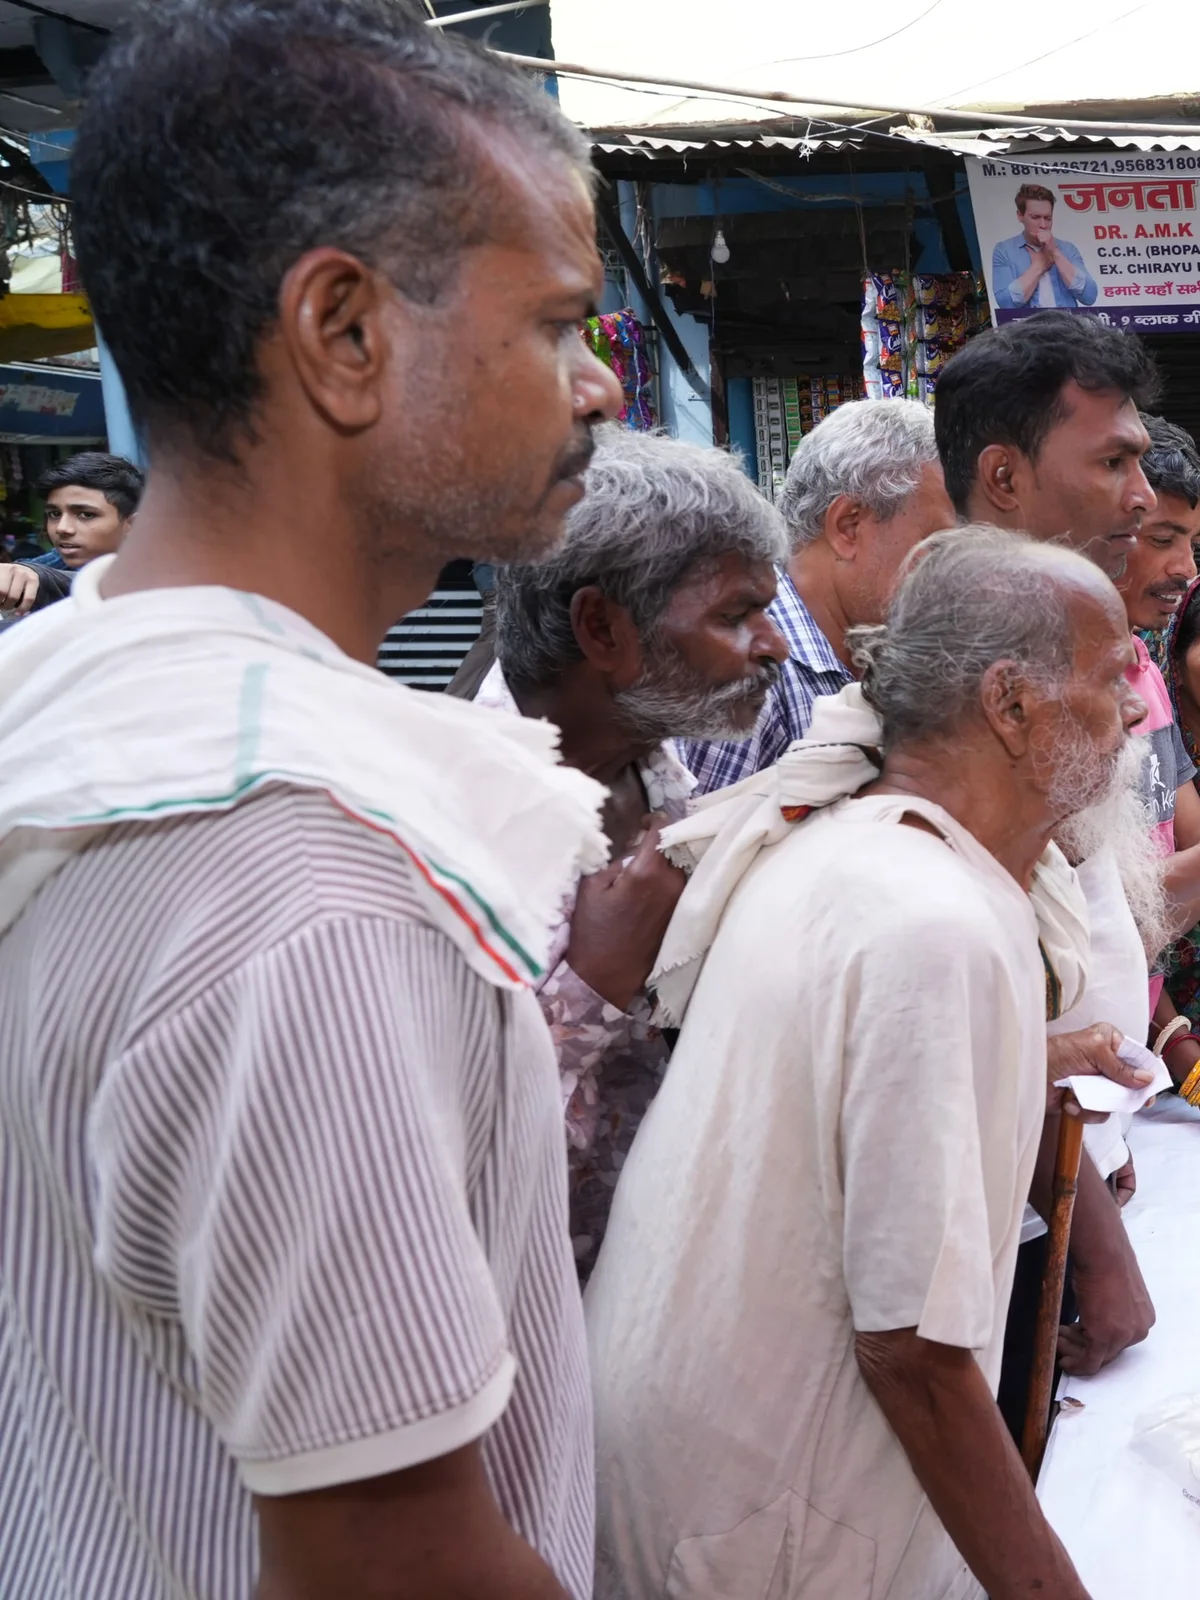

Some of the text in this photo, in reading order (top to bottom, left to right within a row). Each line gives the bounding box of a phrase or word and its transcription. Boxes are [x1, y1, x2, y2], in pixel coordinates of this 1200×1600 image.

[1058, 179, 1197, 212] जनता
[1094, 225, 1128, 240] DR.
[1134, 222, 1194, 239] A.M.K
[1097, 246, 1142, 258] C.C.H.
[1099, 264, 1123, 275] EX.
[1127, 262, 1192, 274] CHIRAYU
[1103, 283, 1141, 297] हमारे
[1145, 281, 1174, 296] यहाँ
[1134, 314, 1179, 327] ब्लाक
